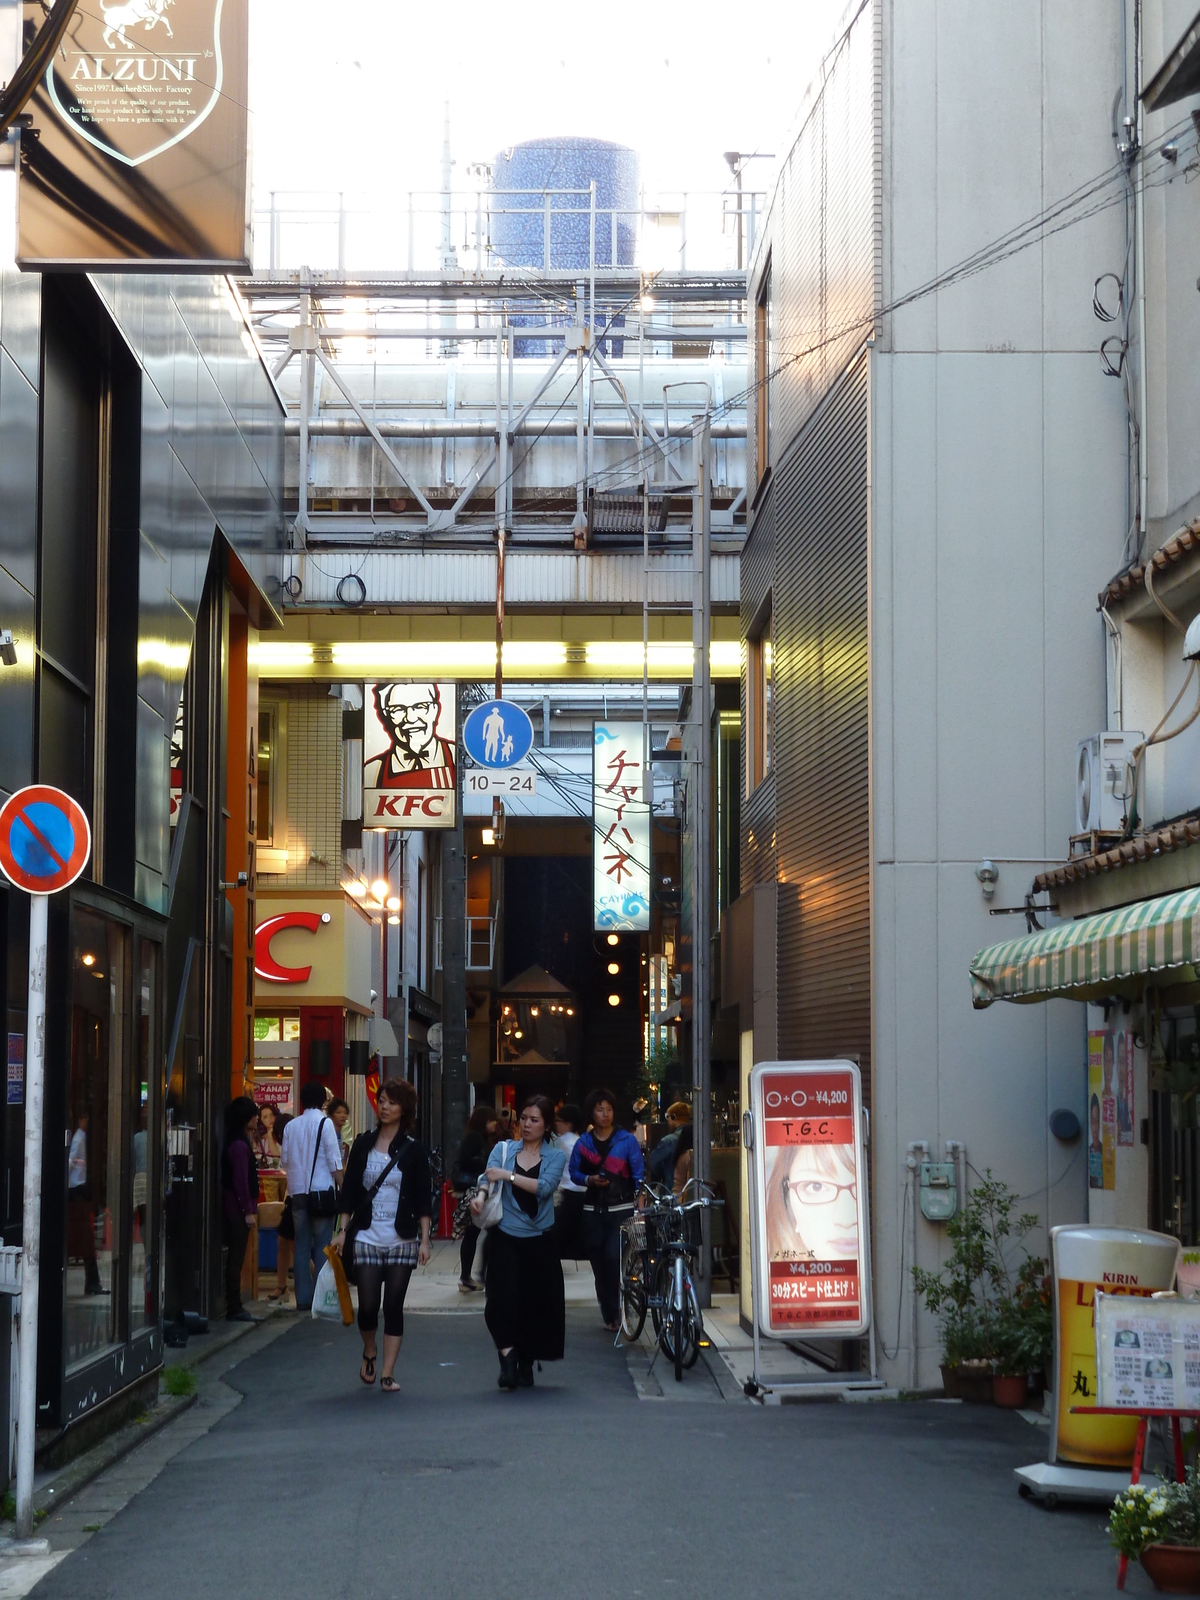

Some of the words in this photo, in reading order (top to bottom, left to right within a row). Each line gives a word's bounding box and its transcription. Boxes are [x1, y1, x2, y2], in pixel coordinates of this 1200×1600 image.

[70, 57, 197, 81] ALZUNI
[166, 85, 193, 94] Factory
[168, 99, 190, 107] product.
[113, 107, 133, 115] product
[152, 107, 163, 115] only
[373, 795, 445, 817] KFC
[604, 750, 640, 885] チャイハネ
[782, 1121, 833, 1137] T.G.C.
[1103, 1272, 1138, 1285] KIRIN
